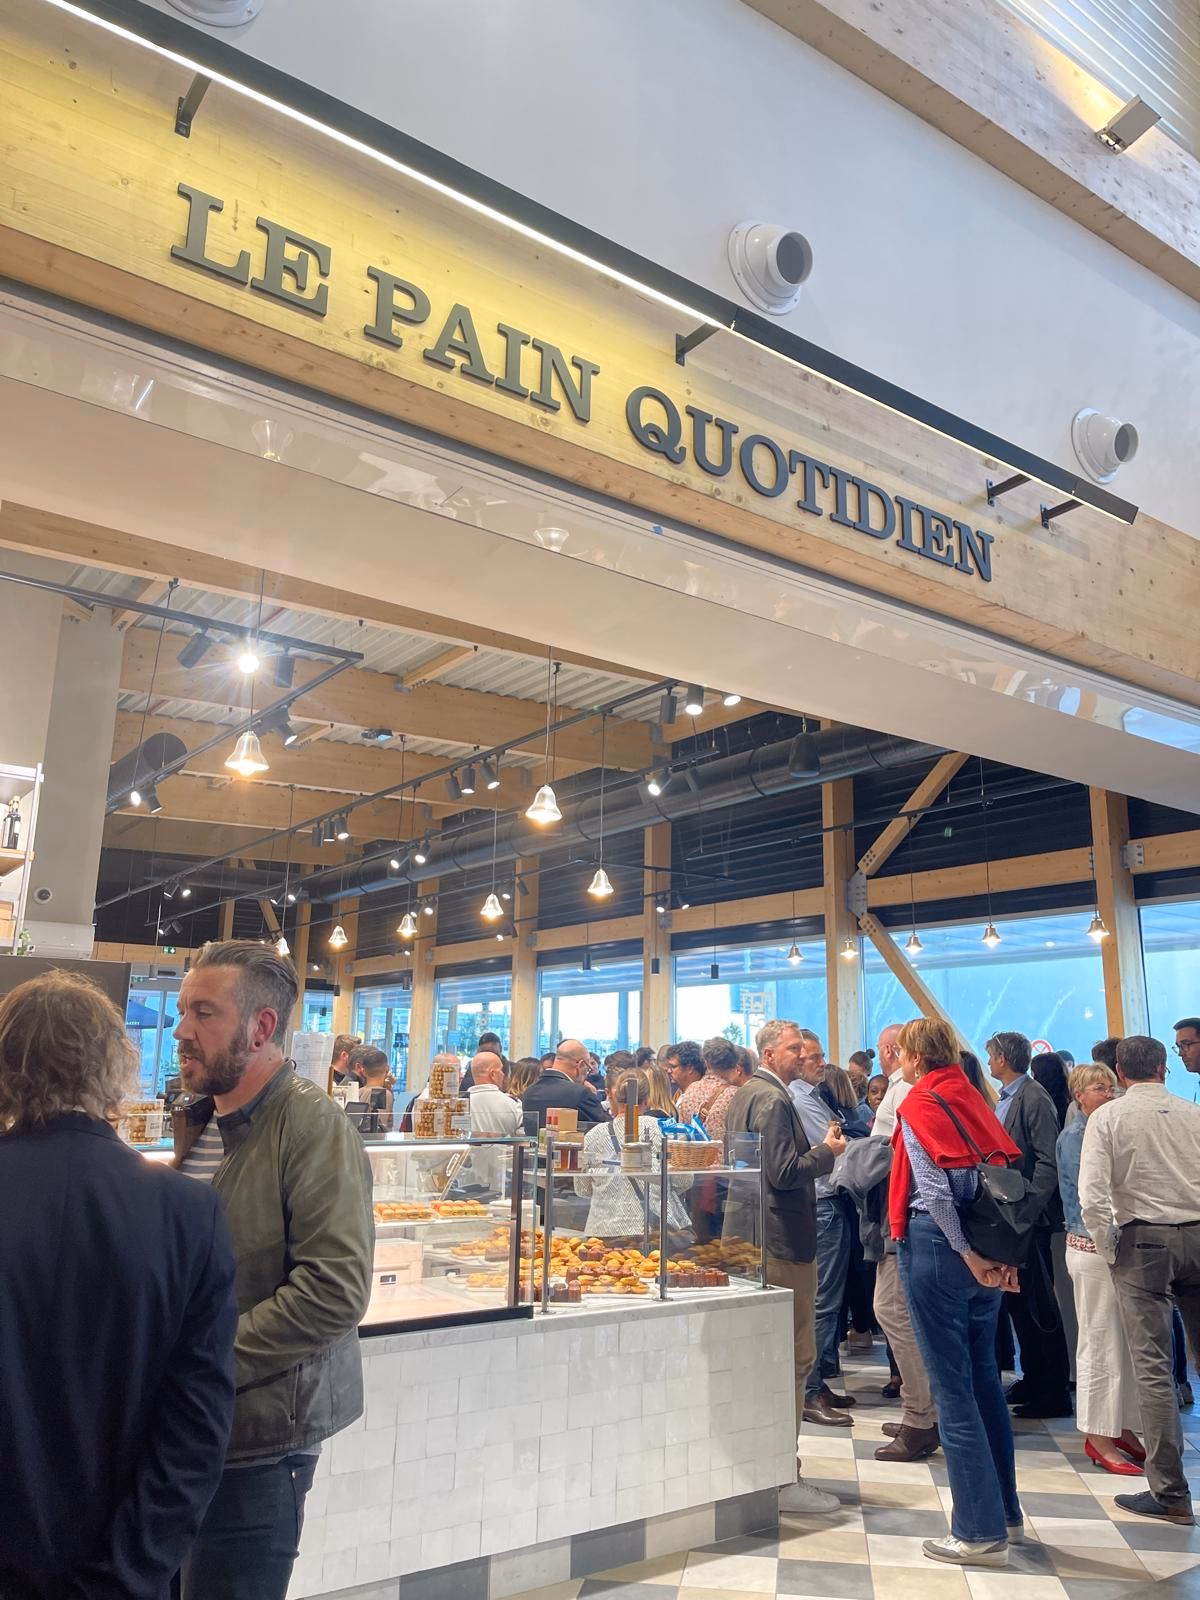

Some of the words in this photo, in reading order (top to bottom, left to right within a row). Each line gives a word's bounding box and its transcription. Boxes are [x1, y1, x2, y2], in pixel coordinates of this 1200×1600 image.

[171, 183, 332, 316] LE
[364, 265, 599, 422] PAIN
[626, 386, 994, 582] QUOTIDIEN
